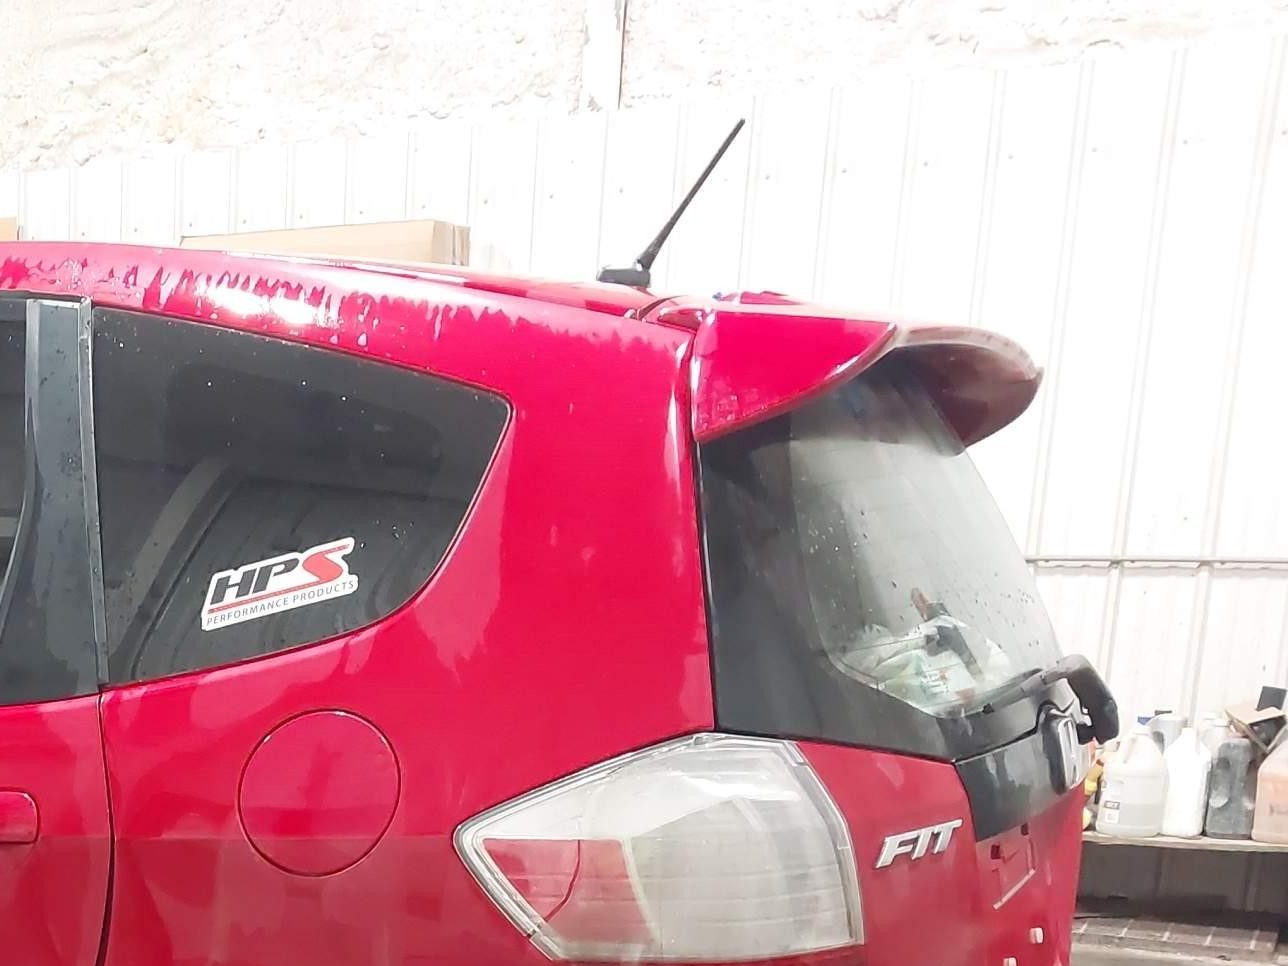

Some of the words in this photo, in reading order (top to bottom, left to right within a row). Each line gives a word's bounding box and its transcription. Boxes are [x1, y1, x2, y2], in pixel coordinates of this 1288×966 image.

[206, 597, 290, 627] PERFORMANCE
[292, 579, 355, 604] PRODUCTS
[208, 544, 351, 614] HPS
[875, 818, 963, 870] FIT
